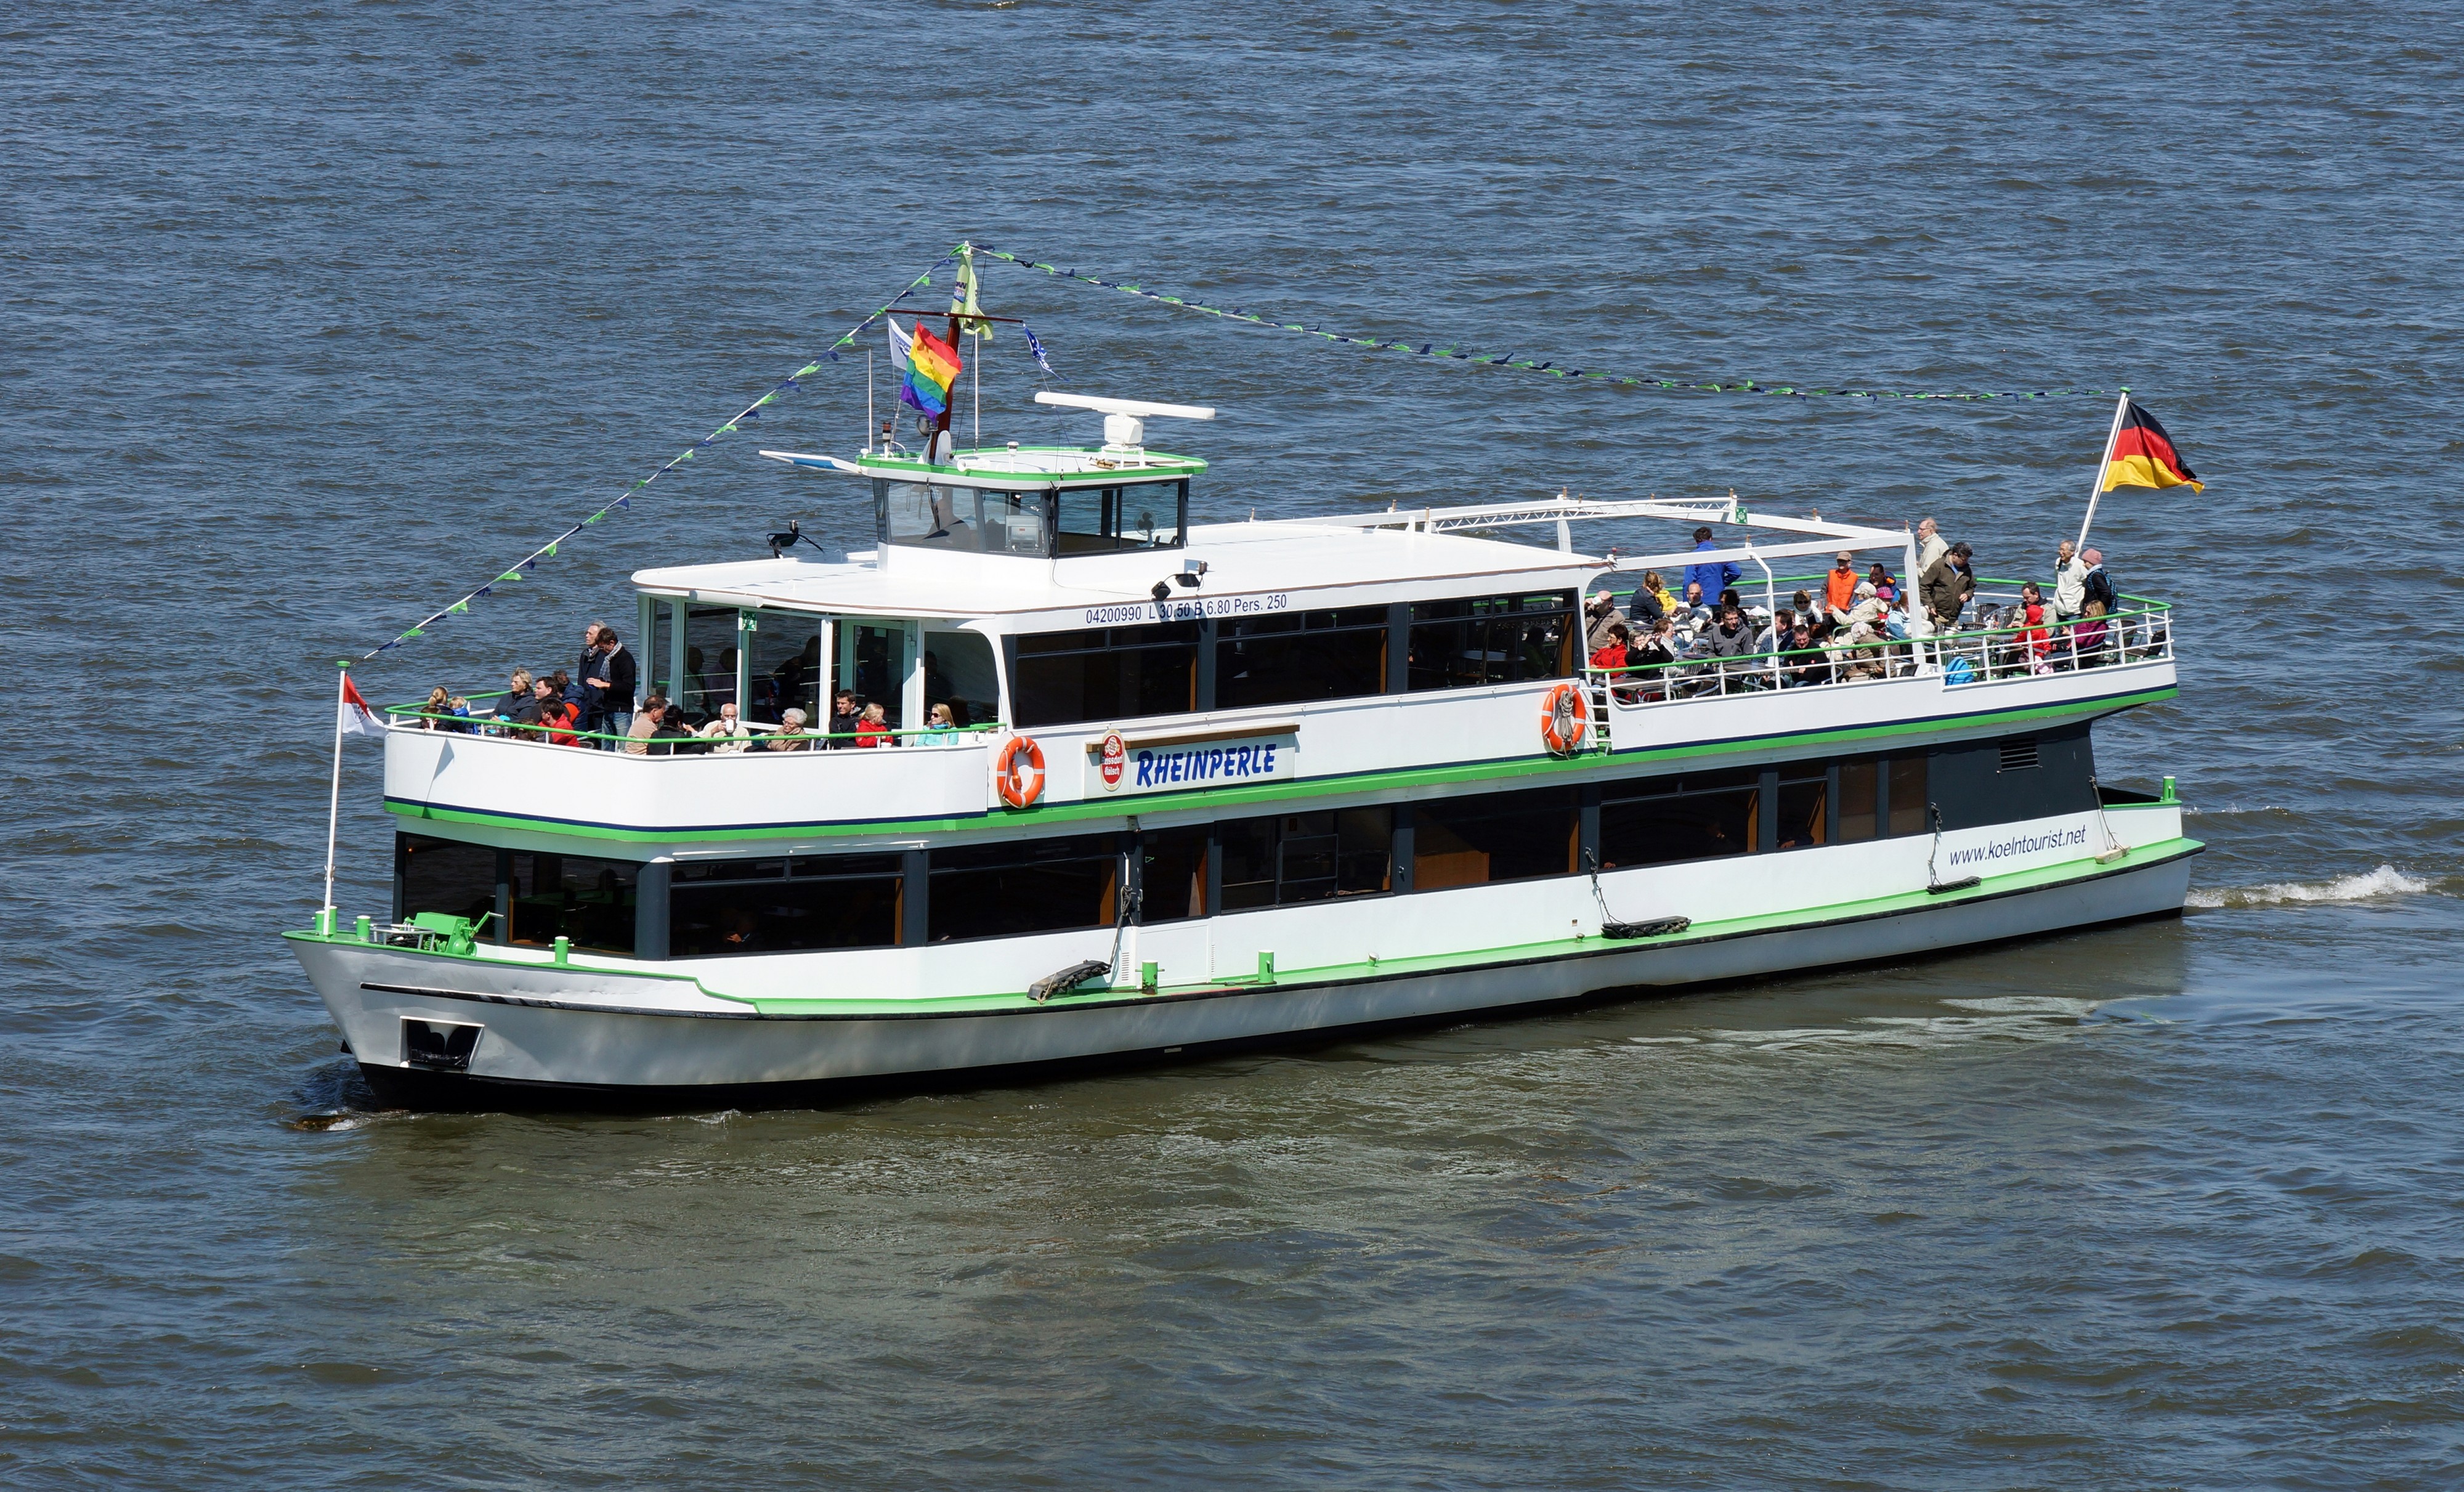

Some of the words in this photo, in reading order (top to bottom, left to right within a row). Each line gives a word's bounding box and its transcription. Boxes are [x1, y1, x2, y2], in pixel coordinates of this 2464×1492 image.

[1086, 606, 1141, 623] 04200990
[1149, 606, 1156, 619] L
[1159, 602, 1190, 619] 30.50
[1194, 601, 1202, 616] B
[1207, 599, 1230, 615] 6.80
[1234, 598, 1263, 613] Pers.
[1267, 594, 1287, 609] 250
[1950, 824, 2086, 866] www.koelntourist.net
